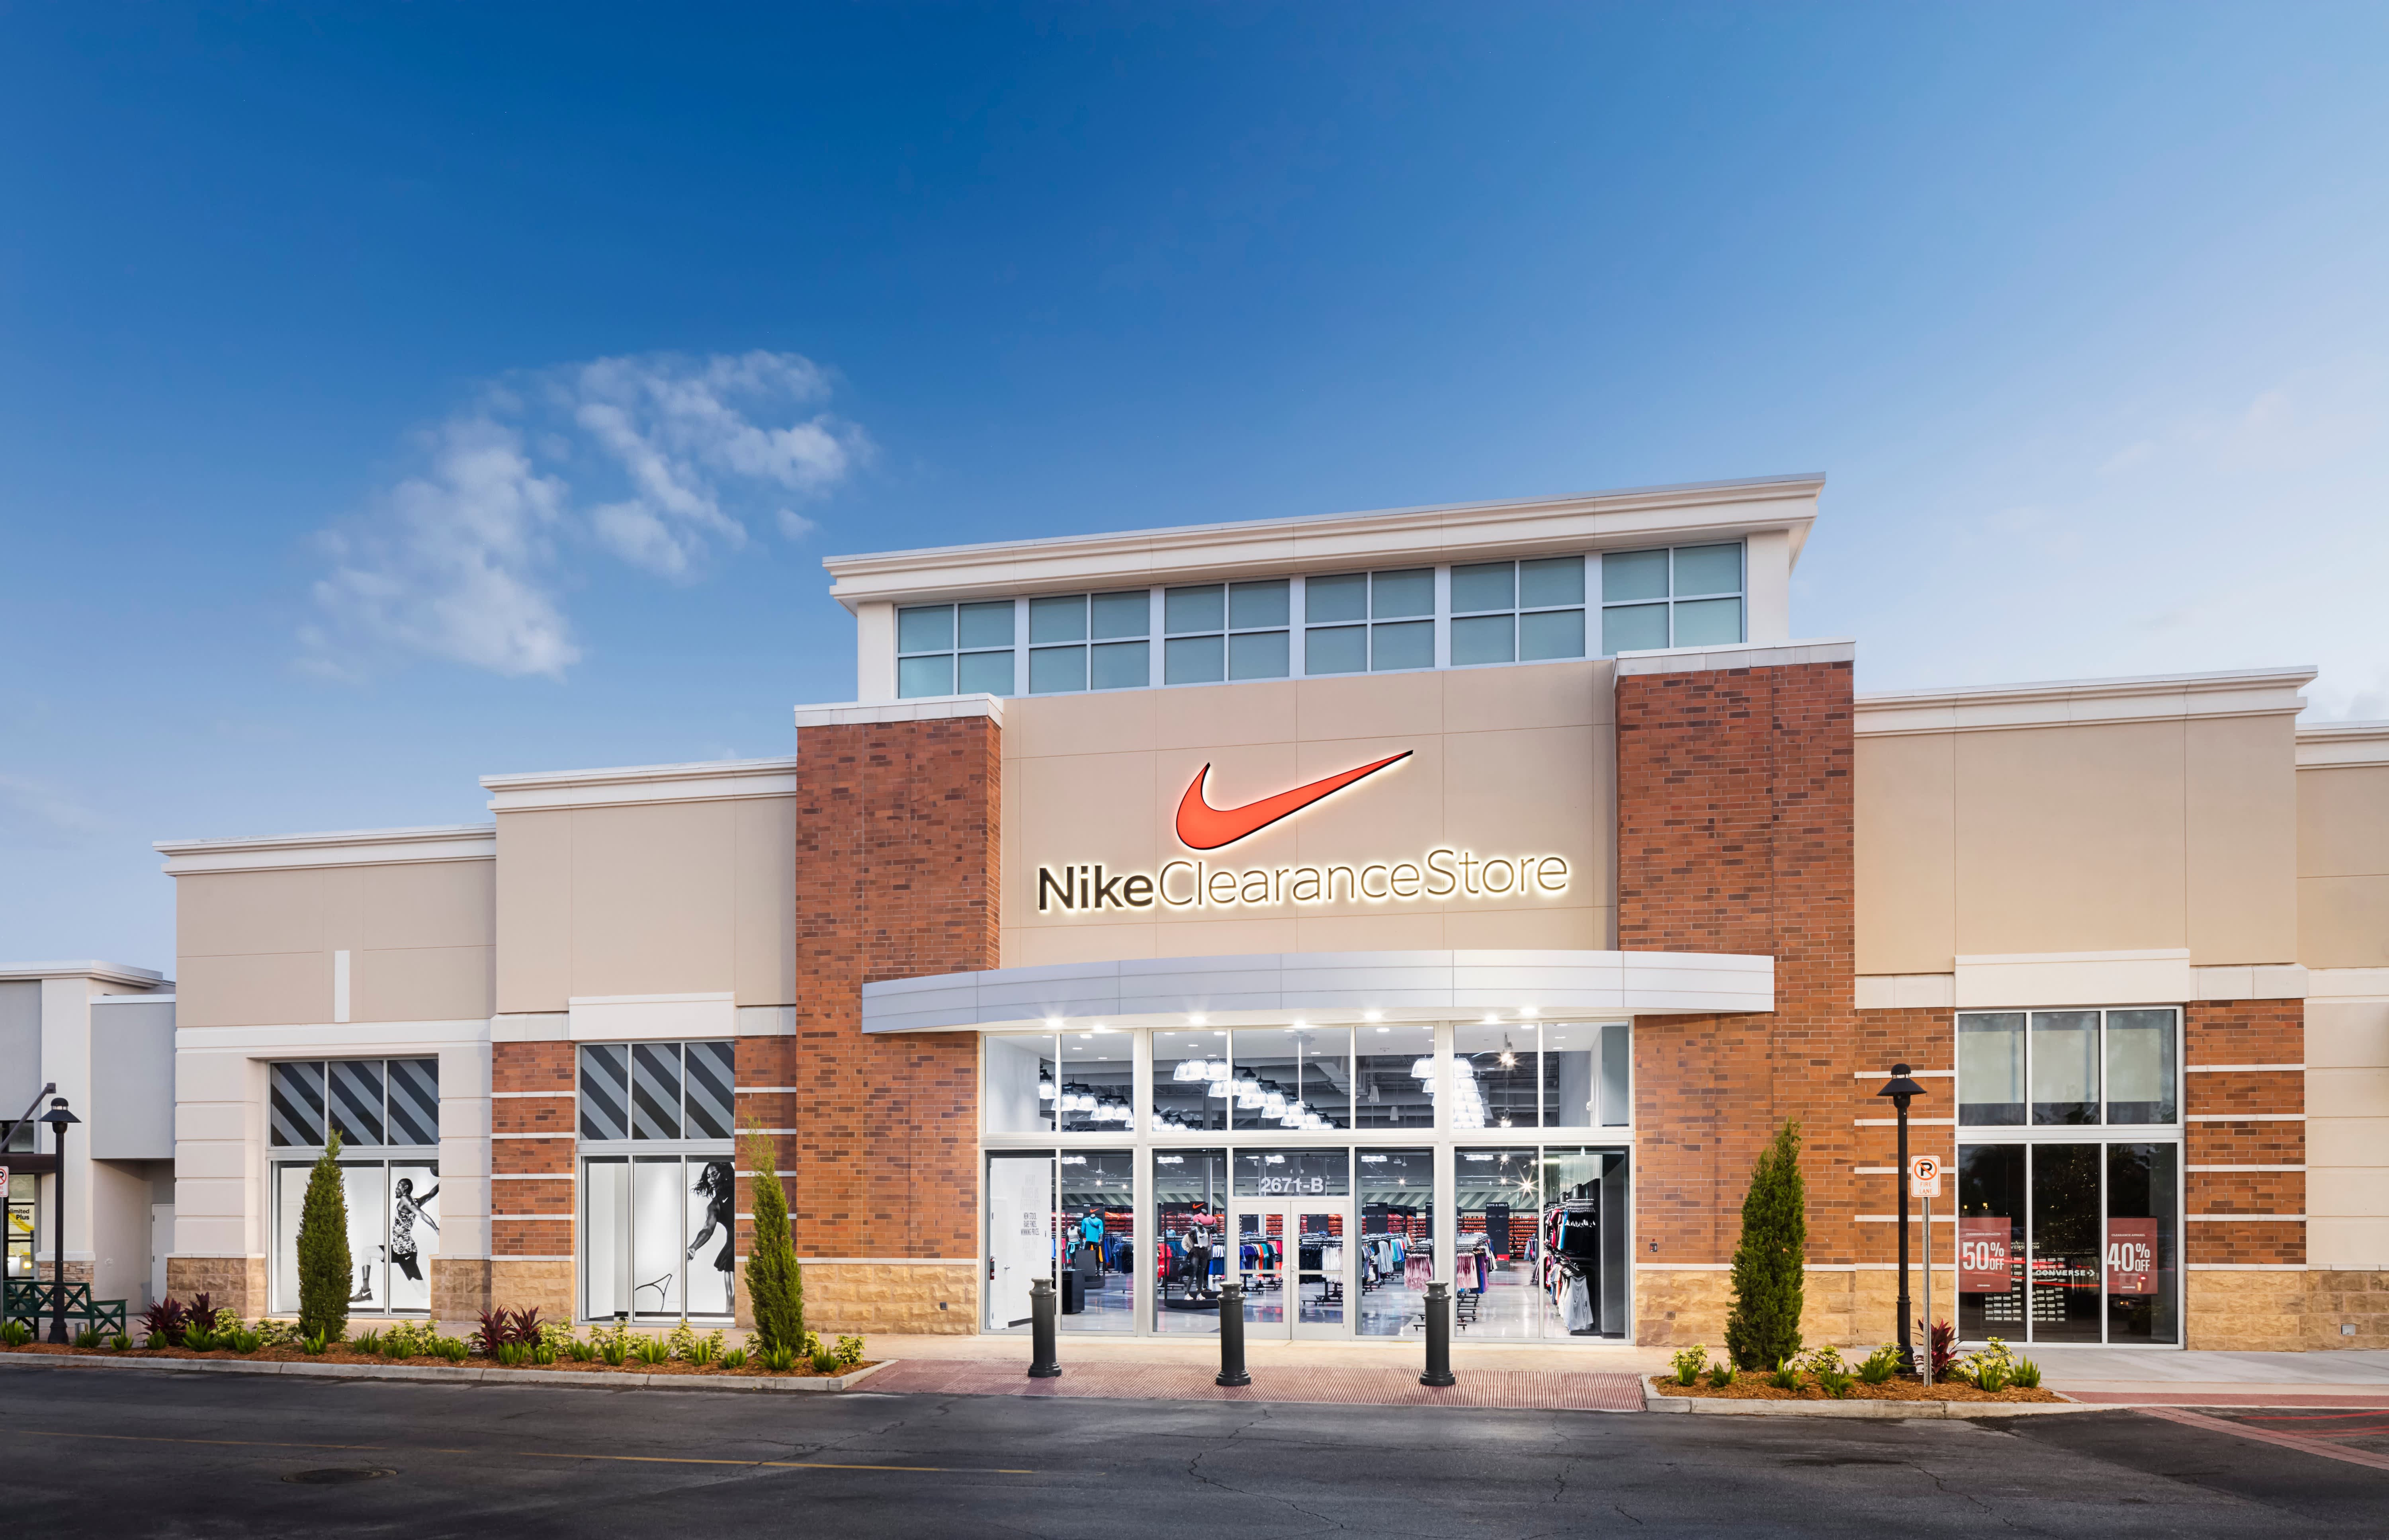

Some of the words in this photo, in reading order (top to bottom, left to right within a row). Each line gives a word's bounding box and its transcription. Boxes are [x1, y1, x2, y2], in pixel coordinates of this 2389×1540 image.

[1261, 1177, 1324, 1192] 2671-B
[1963, 1241, 2004, 1270] 50%
[2107, 1243, 2150, 1272] 40%
[1989, 1258, 2004, 1270] OFF
[2135, 1259, 2150, 1272] OFF
